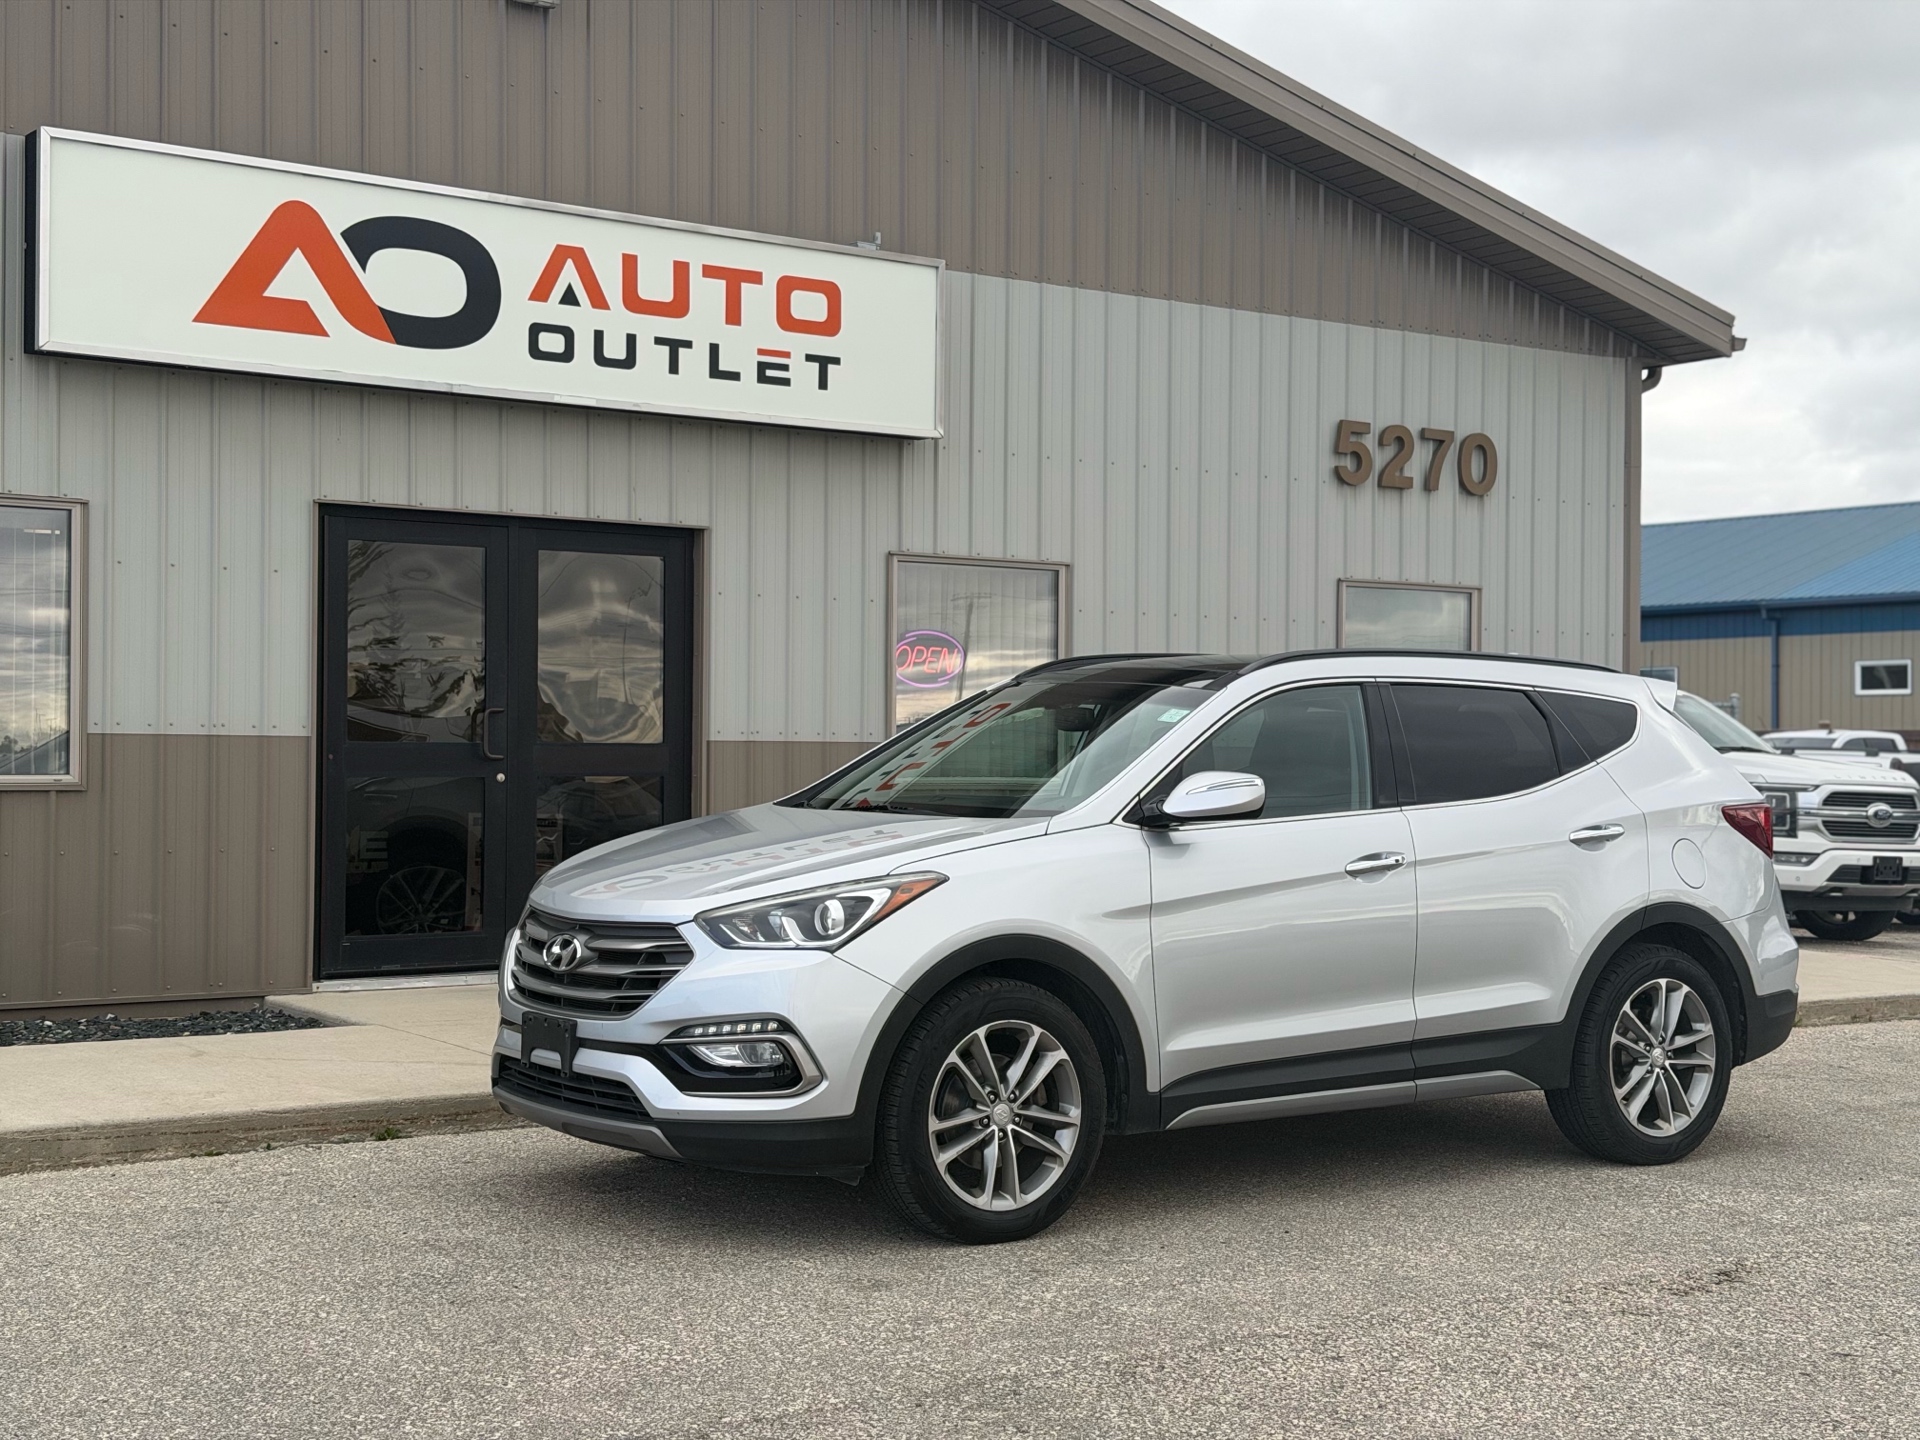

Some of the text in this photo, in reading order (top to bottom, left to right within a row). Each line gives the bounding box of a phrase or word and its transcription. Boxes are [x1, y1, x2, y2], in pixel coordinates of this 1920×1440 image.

[527, 243, 842, 338] AUTO
[528, 321, 842, 391] OUTLET
[1334, 420, 1498, 496] 5270
[895, 645, 959, 674] OPEN
